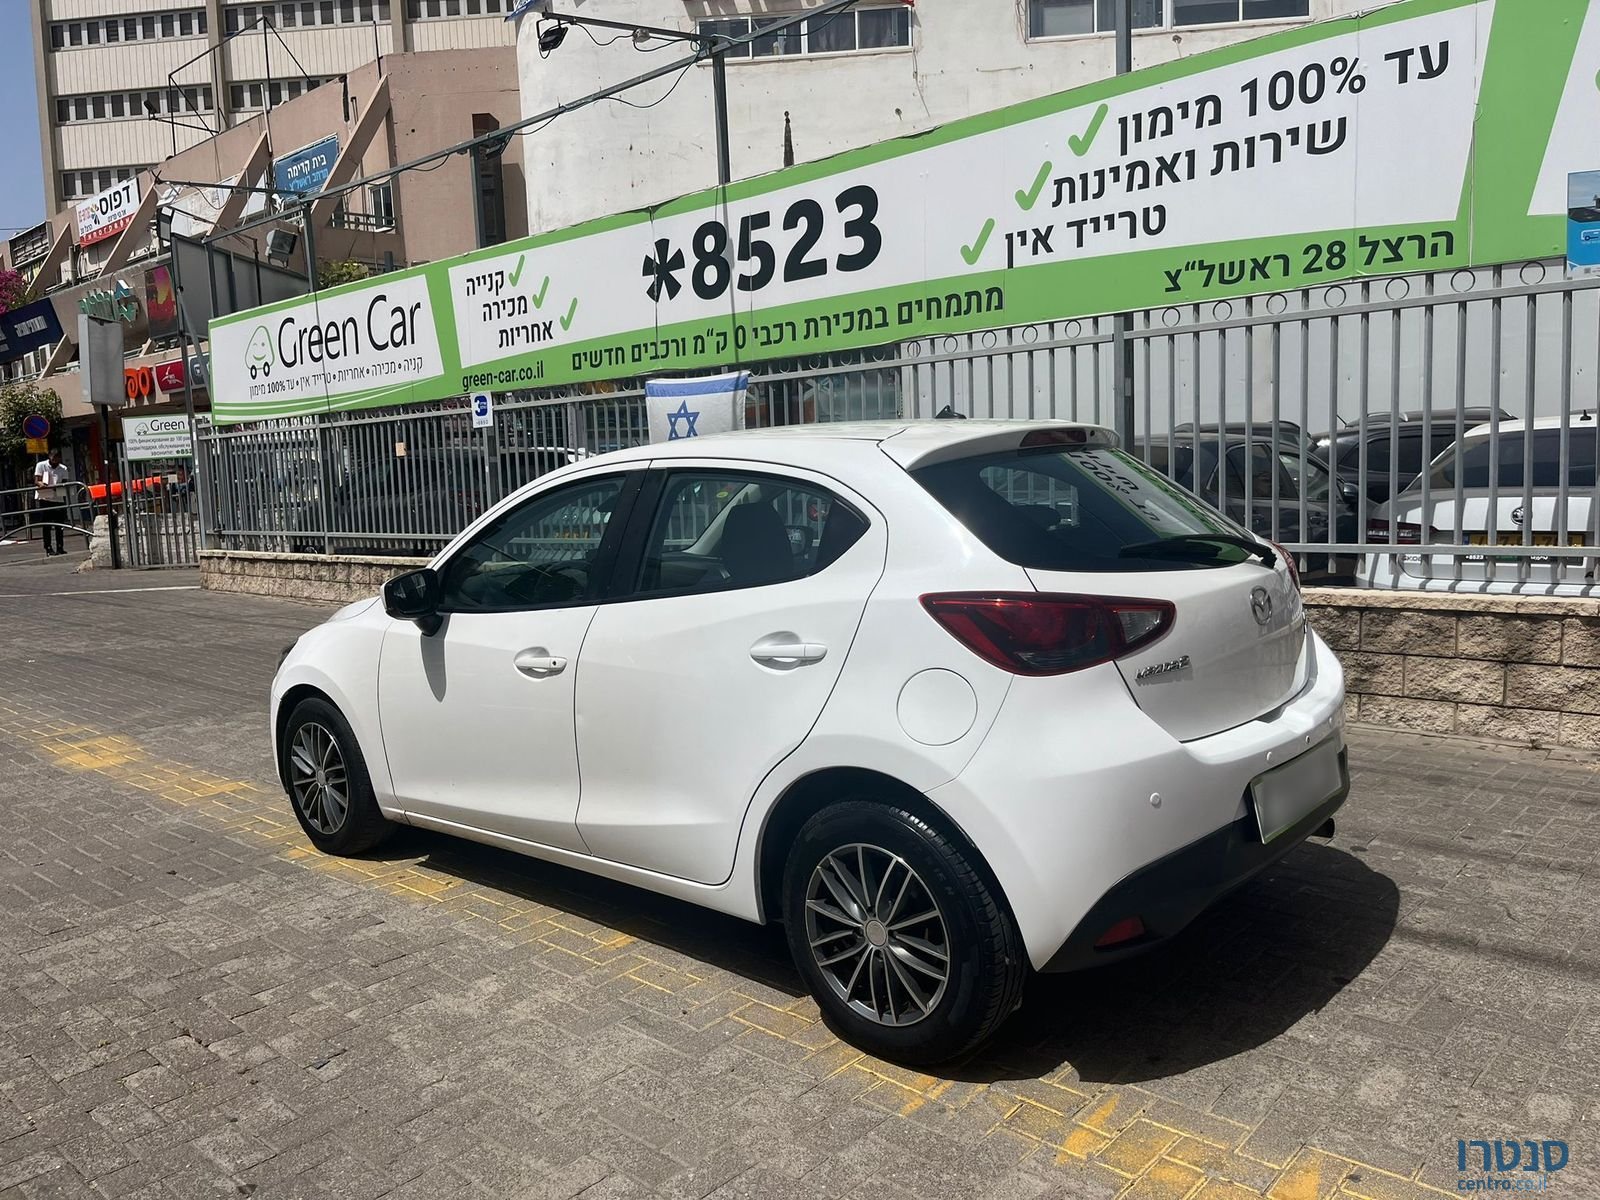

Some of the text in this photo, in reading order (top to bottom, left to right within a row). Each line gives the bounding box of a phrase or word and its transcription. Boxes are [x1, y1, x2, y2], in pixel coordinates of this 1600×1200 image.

[1118, 40, 1450, 157] עד 100% מימון
[287, 154, 327, 179] בית קדימה
[1052, 116, 1347, 208] שירות ואמינות
[99, 185, 130, 215] דפוס
[1005, 204, 1167, 269] טרייד אין
[1163, 230, 1454, 293] הרצל 28 ראשל"צ
[466, 270, 504, 297] קנייה
[483, 295, 528, 322] מכירה
[278, 294, 421, 369] Green Car
[498, 320, 554, 349] אחריות
[572, 286, 1004, 371] מתמחים במכירת רכבי 0 ק"מ ורכבים חדשים
[337, 366, 365, 383] אחריות
[371, 361, 397, 377] מכירה
[403, 356, 424, 374] קניה
[462, 360, 544, 392] green-car.co.il
[267, 380, 286, 394] 100%
[150, 420, 185, 431] Green
